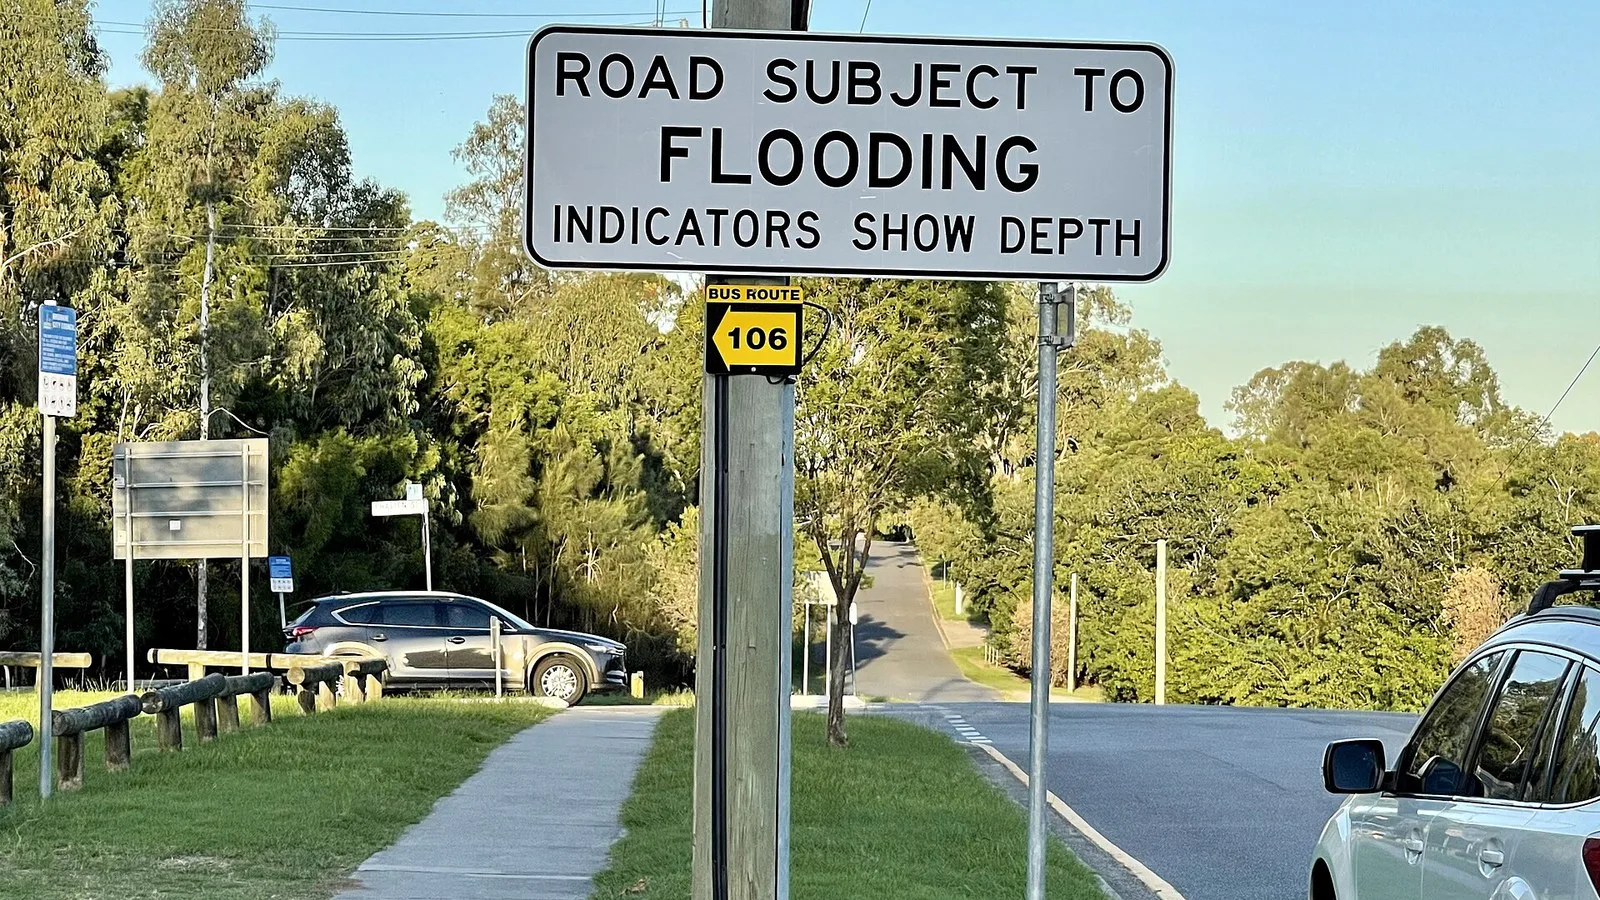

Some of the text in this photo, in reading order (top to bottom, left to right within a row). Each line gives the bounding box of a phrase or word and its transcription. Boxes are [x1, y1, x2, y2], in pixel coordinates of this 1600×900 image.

[556, 51, 1145, 113] ROAD SUBJECT TO
[660, 126, 1039, 193] FLOODING
[553, 204, 1141, 256] INDICATORS SHOW DEPTH
[708, 288, 800, 301] BUS ROUTE
[728, 327, 788, 350] 106
